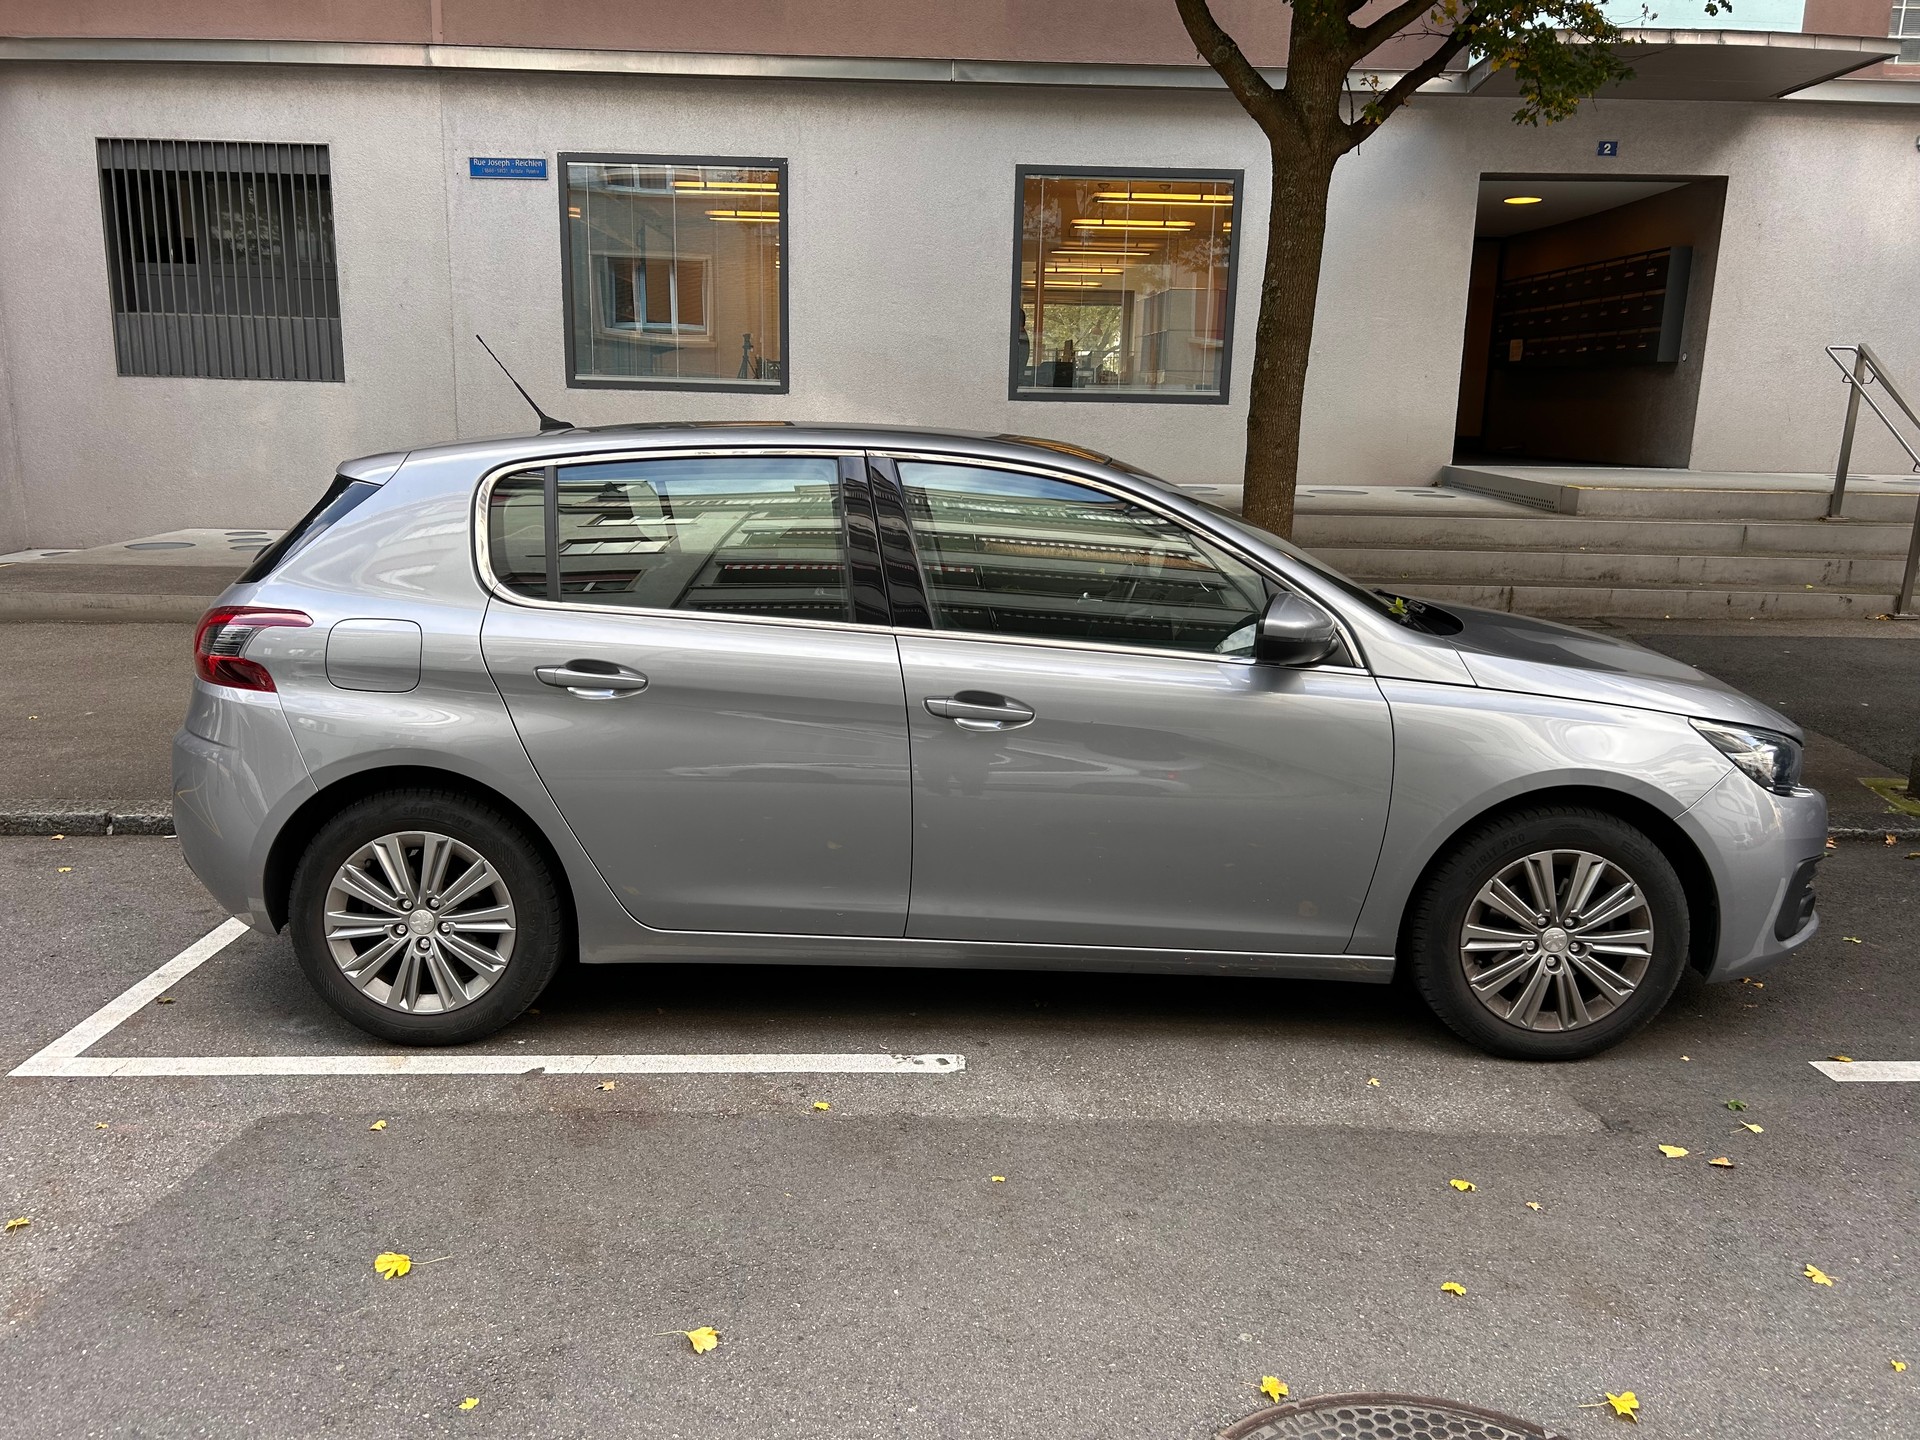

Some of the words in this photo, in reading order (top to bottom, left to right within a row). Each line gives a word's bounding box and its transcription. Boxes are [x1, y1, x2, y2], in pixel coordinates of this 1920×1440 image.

[1604, 143, 1611, 154] 2
[473, 158, 486, 166] Rue
[488, 159, 510, 167] Joseph
[402, 806, 443, 817] SPIRIT
[1465, 846, 1497, 878] SPIRIT
[1502, 833, 1525, 849] PRO
